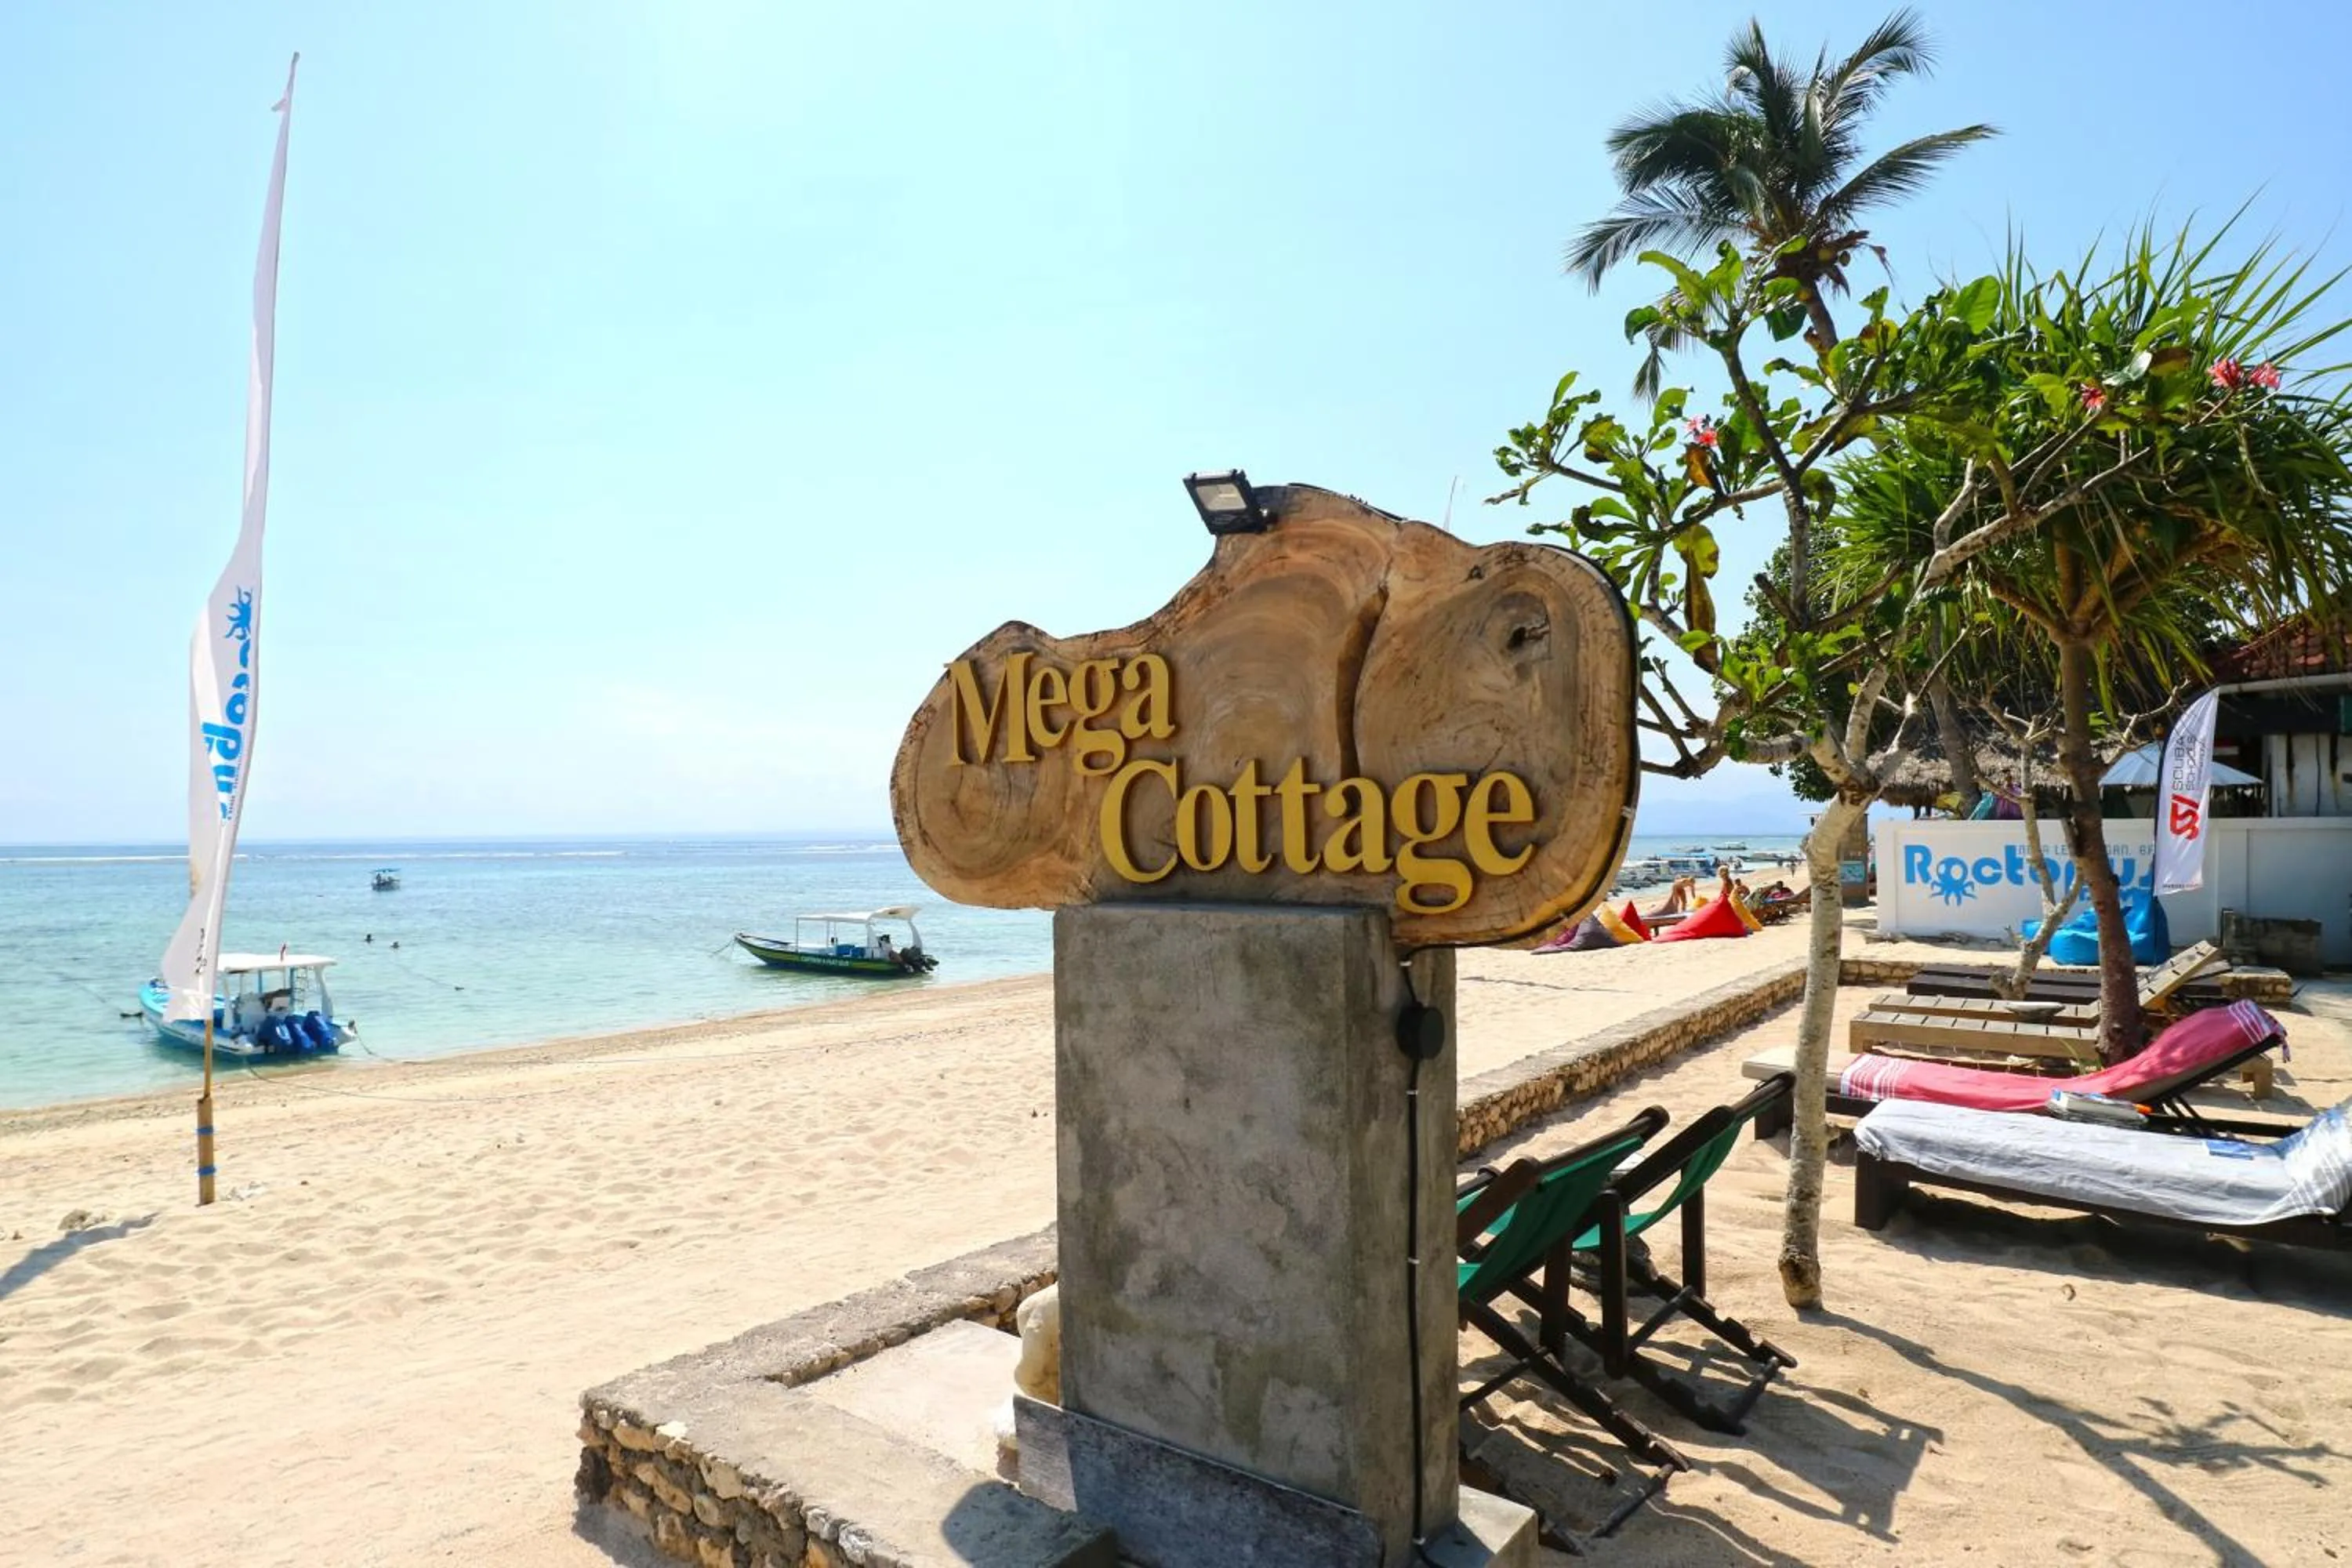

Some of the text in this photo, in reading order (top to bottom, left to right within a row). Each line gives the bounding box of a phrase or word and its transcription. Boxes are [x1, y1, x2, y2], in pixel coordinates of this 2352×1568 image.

[943, 652, 1175, 776] Mega
[2172, 736, 2184, 790] SCUBA
[1100, 757, 1538, 915] Cottage
[1904, 844, 2153, 906] Roctou
